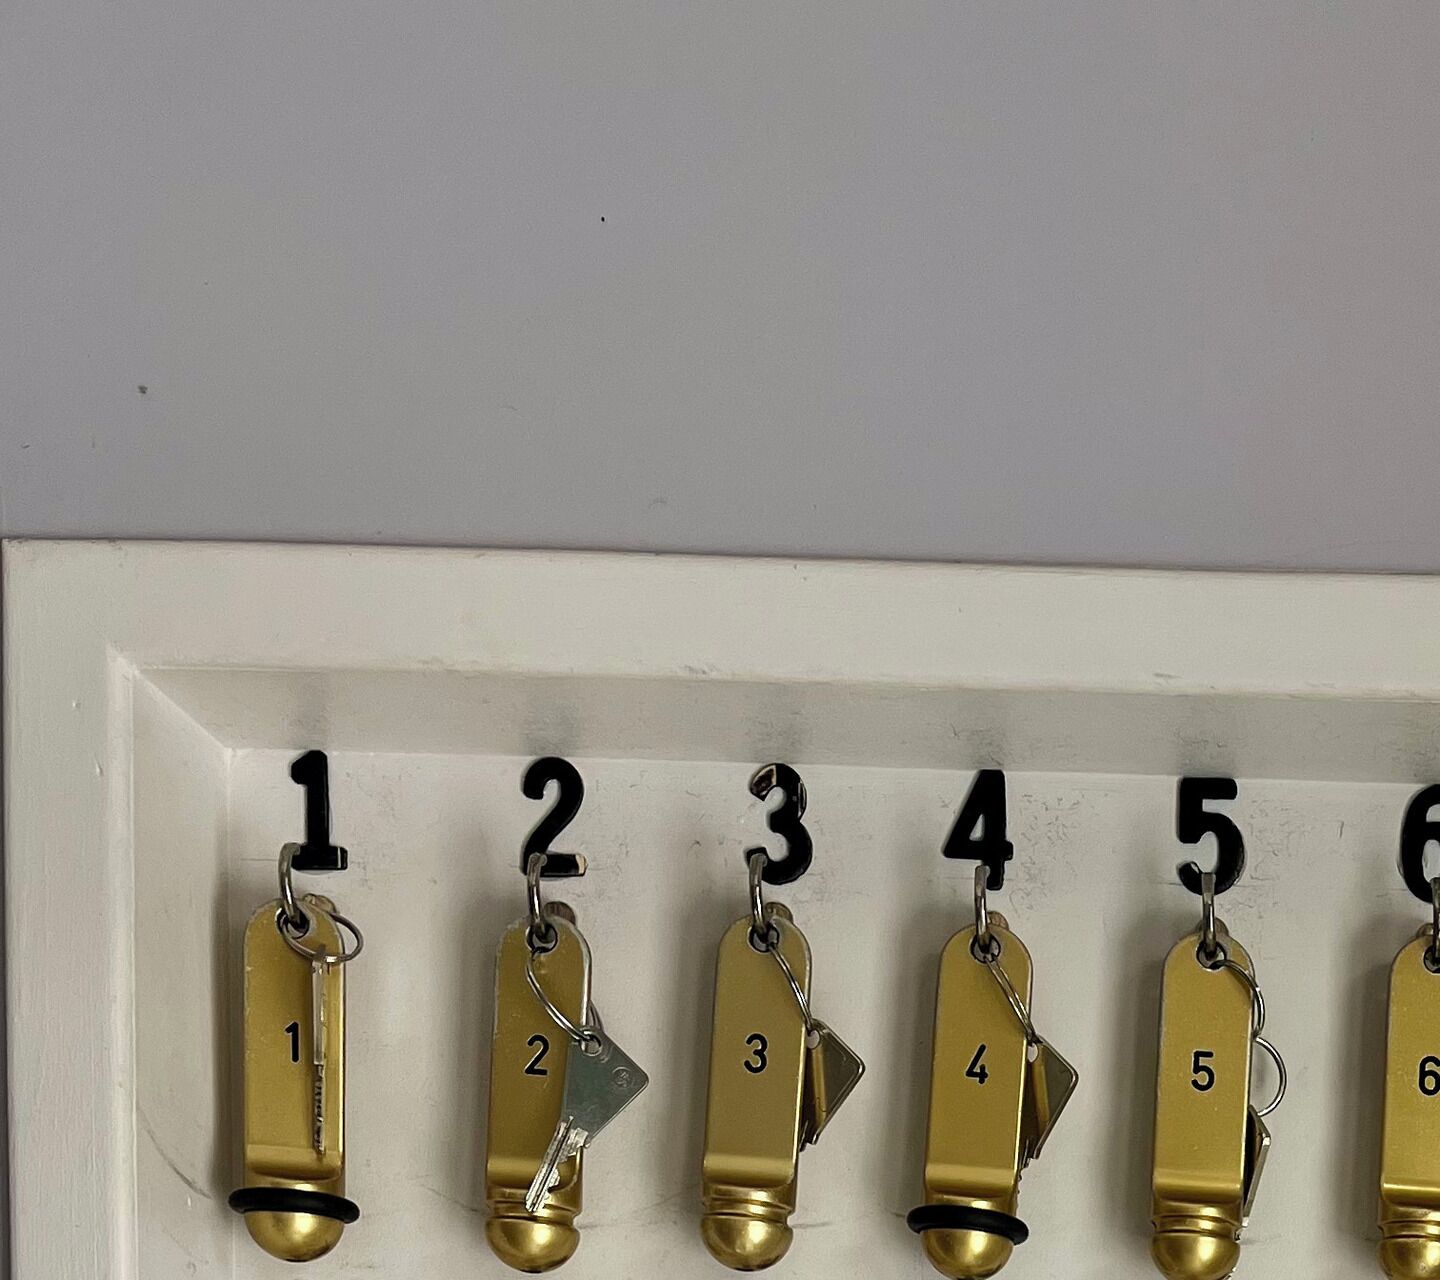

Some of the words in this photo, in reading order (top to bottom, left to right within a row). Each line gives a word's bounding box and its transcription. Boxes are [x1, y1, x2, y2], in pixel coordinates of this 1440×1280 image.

[291, 750, 348, 870] 1
[521, 756, 588, 876] 2
[746, 762, 812, 884] 3
[943, 769, 1014, 890] 4
[1176, 778, 1244, 894] 5
[284, 1022, 301, 1062] 1
[524, 1034, 549, 1076] 2
[743, 1034, 768, 1074] 3
[966, 1044, 989, 1084] 4
[1191, 1051, 1215, 1091] 5
